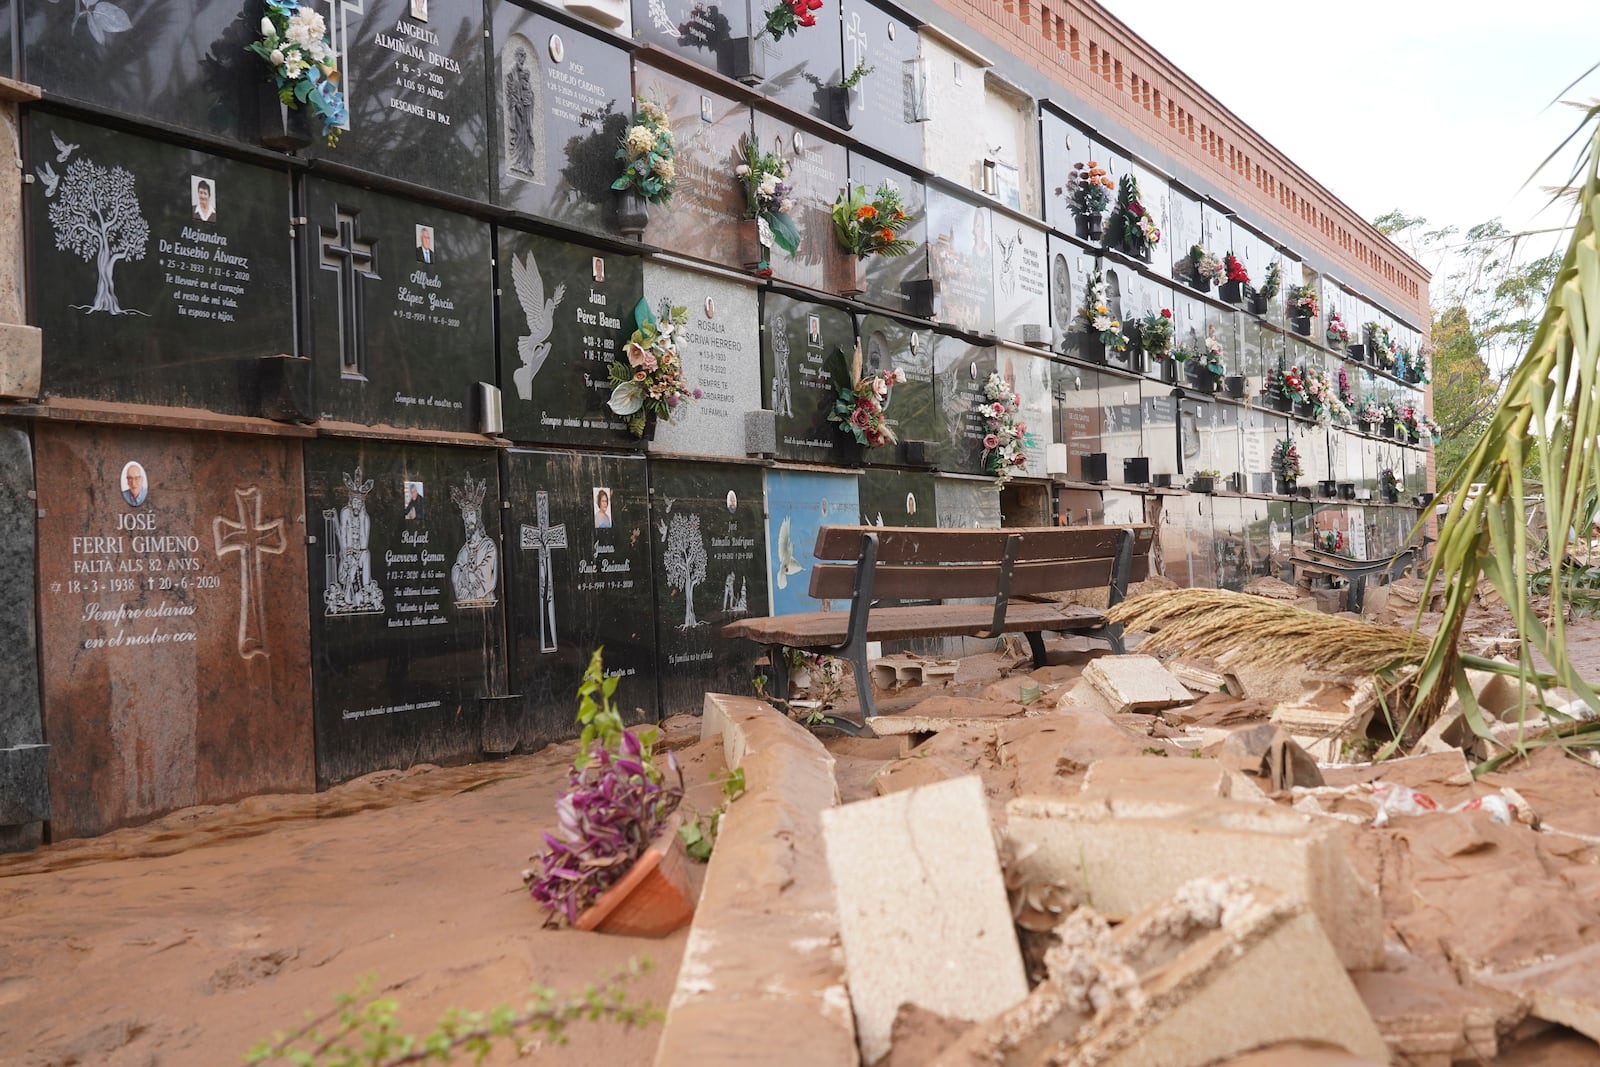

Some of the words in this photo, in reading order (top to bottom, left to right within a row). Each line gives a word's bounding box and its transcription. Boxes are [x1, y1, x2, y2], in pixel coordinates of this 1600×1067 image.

[396, 20, 440, 46] ANGELITA
[374, 32, 425, 61] ALMIÑANA
[428, 51, 461, 74] DEVESA
[396, 77, 401, 86] A
[403, 79, 415, 90] LOS
[417, 84, 425, 94] 93
[427, 86, 444, 100] AÑOS
[390, 98, 424, 117] DESCANSE
[426, 109, 435, 120] EN
[438, 112, 450, 125] PAZ
[181, 226, 227, 246] Alejandra
[159, 240, 172, 253] De
[174, 242, 210, 260] Eusebio
[213, 246, 248, 269] Álvarez
[165, 273, 173, 283] Te
[175, 276, 198, 287] llevaré
[200, 281, 209, 289] en
[210, 282, 217, 290] el
[219, 284, 244, 294] corazón
[410, 270, 442, 289] Alfredo
[173, 290, 181, 299] el
[182, 293, 200, 302] resto
[201, 294, 210, 304] de
[211, 296, 220, 305] mi
[398, 286, 424, 307] López
[428, 292, 454, 311] García
[588, 288, 606, 306] Juan
[178, 305, 186, 315] Tu
[188, 308, 210, 318] esposo
[576, 307, 596, 325] Pérez
[599, 311, 621, 329] Baena
[682, 332, 710, 346] SCRIVA
[711, 339, 742, 352] HERRERO
[116, 510, 157, 531] JOSÉ
[72, 536, 123, 554] FERRI
[132, 536, 200, 553] GIMENO
[401, 530, 429, 548] Rafael
[593, 540, 615, 558] Juana
[74, 556, 113, 573] FALTÀ
[119, 559, 143, 572] ALS
[149, 558, 162, 571] 82
[167, 558, 200, 571] ANYS
[385, 549, 418, 567] Guerrero
[82, 602, 144, 627] Sempre
[84, 638, 106, 649] en
[108, 629, 124, 647] el
[126, 627, 171, 646] nostre
[173, 631, 197, 642] cor.
